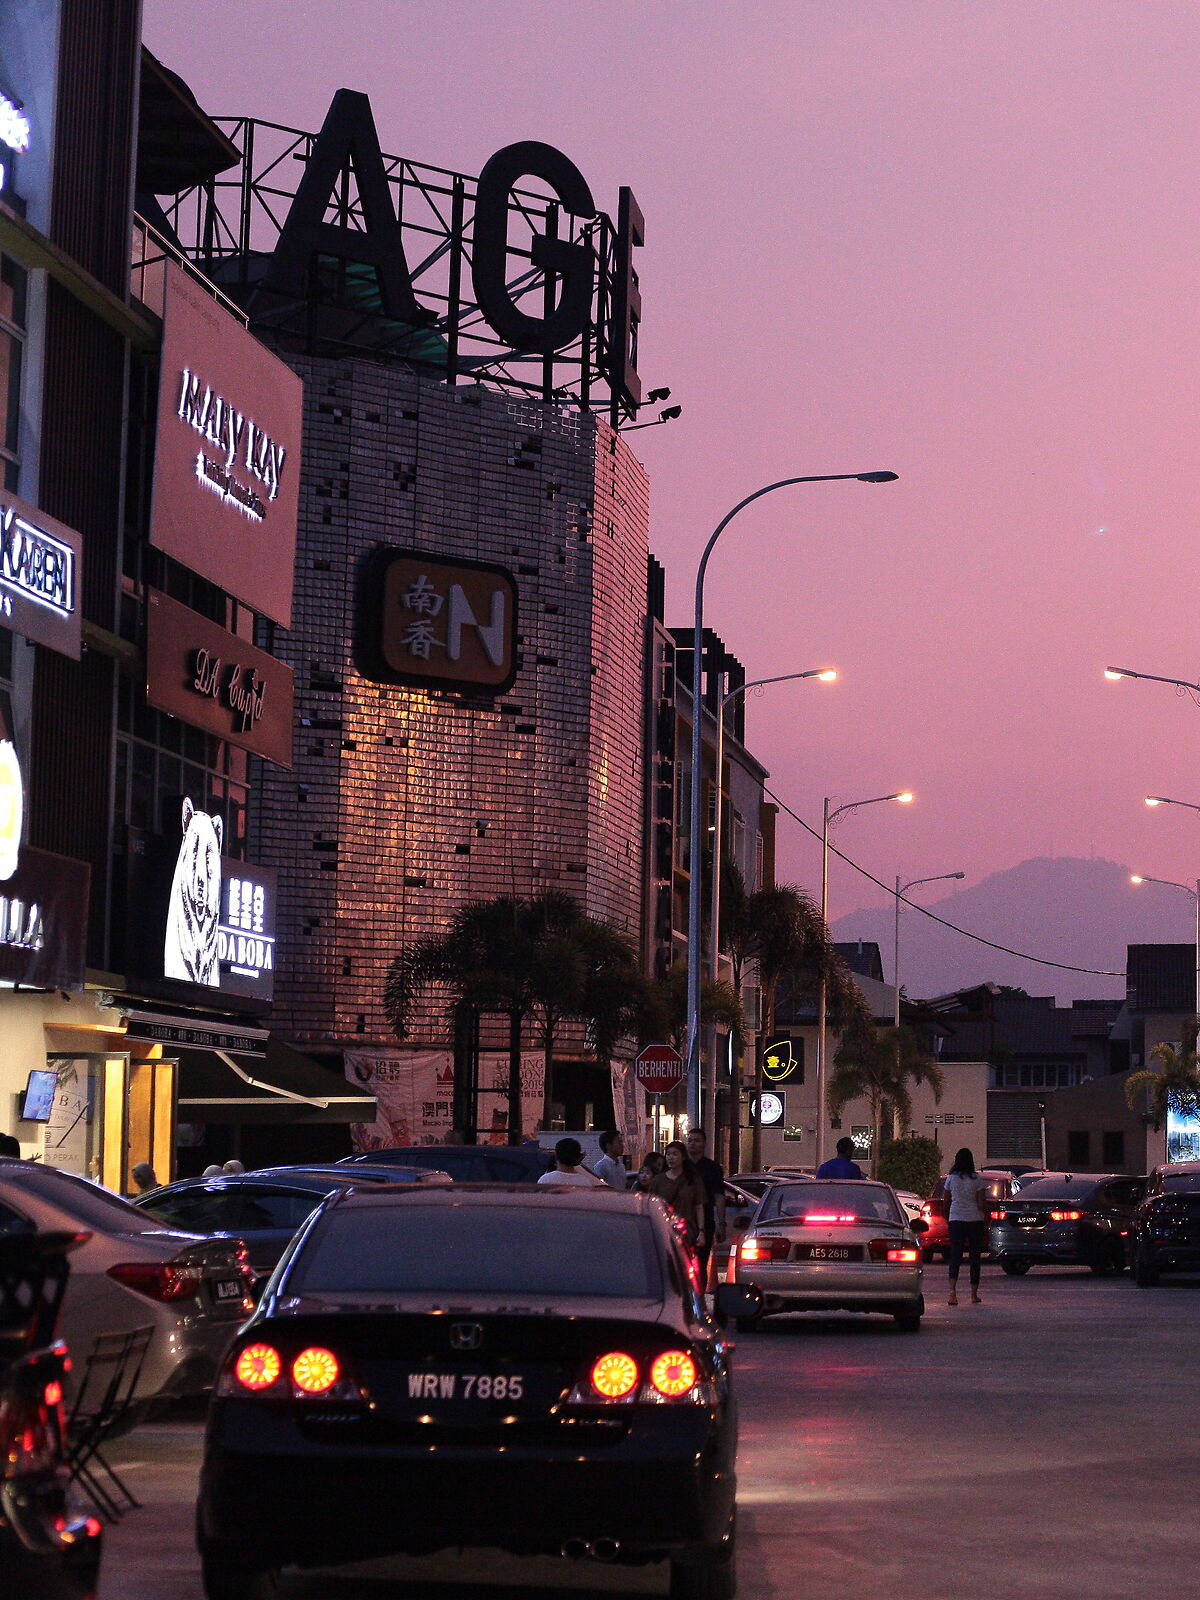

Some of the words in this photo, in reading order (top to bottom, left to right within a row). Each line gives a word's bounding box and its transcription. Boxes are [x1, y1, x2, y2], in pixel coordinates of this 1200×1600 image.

[177, 366, 244, 469] MARY
[245, 418, 287, 502] KAY
[398, 574, 447, 662] 南香
[448, 583, 505, 667] N
[218, 931, 273, 970] DABOBA
[638, 1060, 682, 1078] BERHENTI
[809, 1247, 827, 1259] AES
[407, 1374, 456, 1400] WRW
[461, 1374, 524, 1400] 7885
